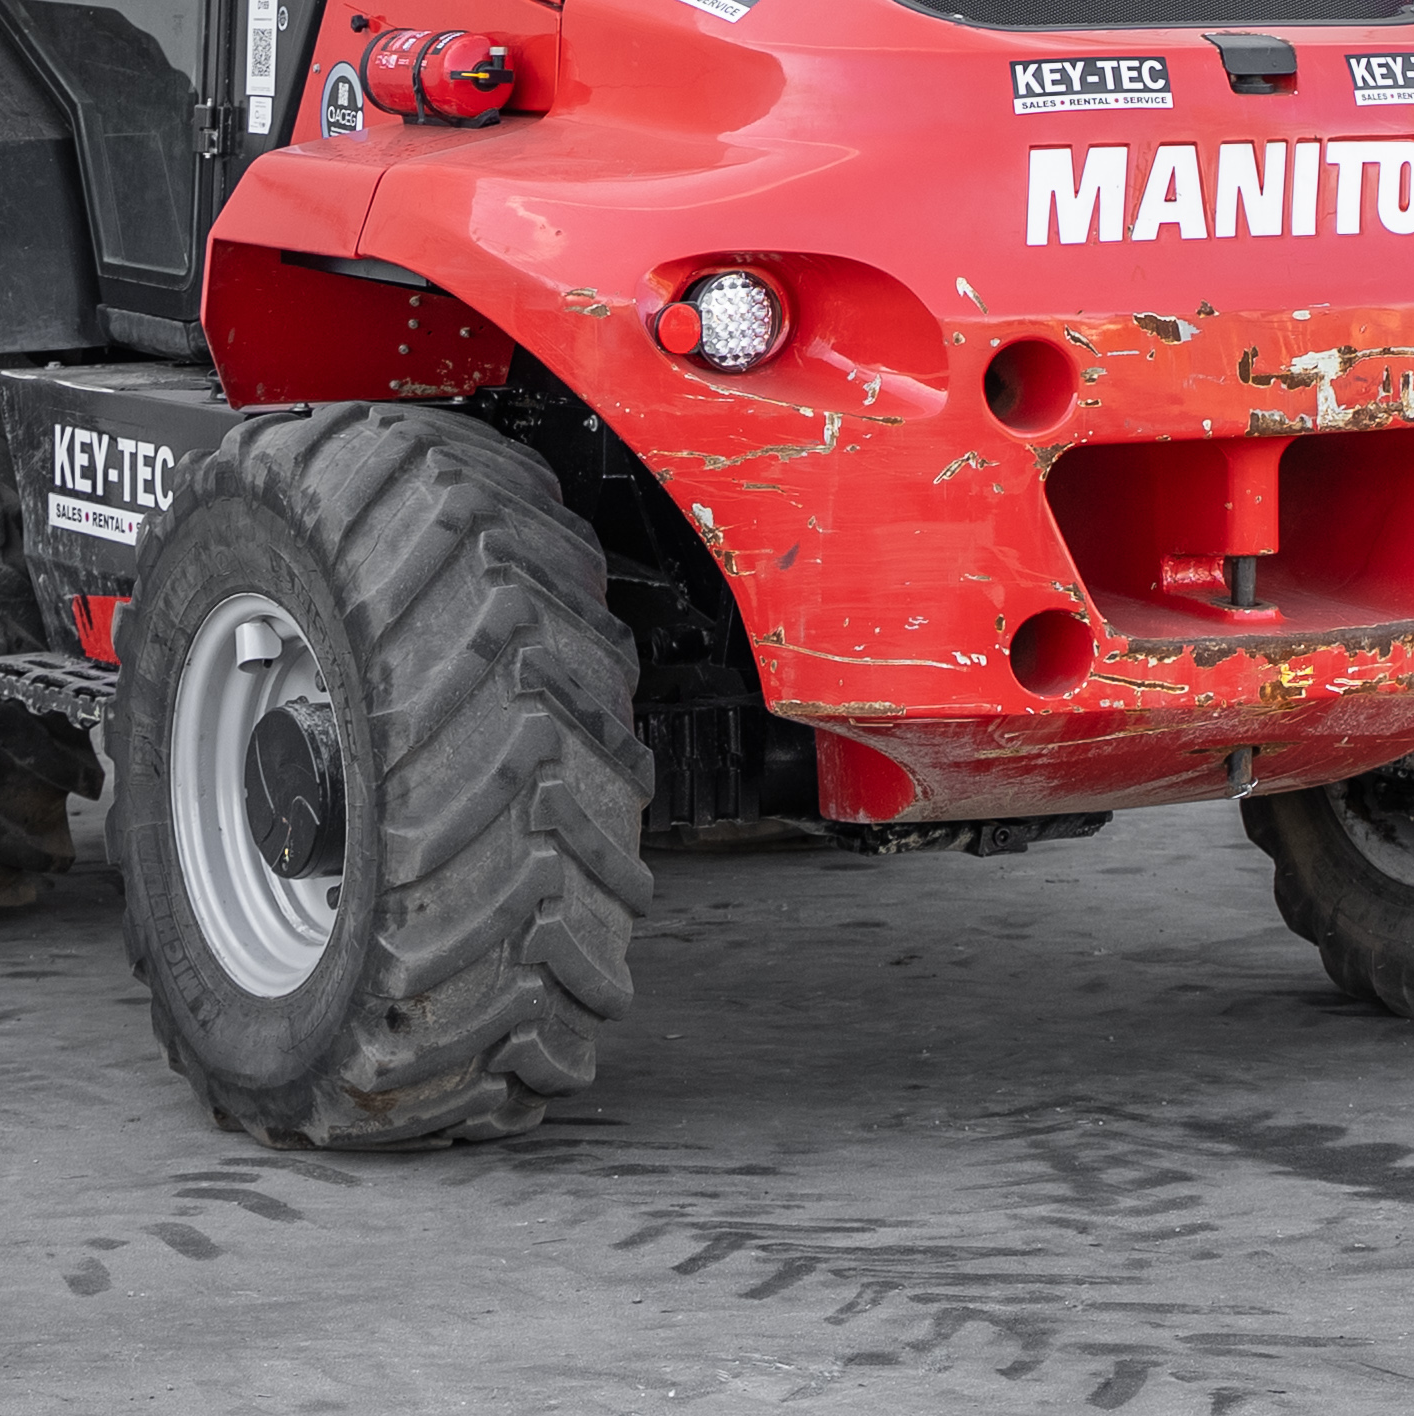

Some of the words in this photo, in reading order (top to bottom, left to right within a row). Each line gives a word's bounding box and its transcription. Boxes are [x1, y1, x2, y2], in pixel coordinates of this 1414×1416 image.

[1015, 60, 1166, 95] KEY-TEC
[1021, 99, 1057, 110] SALES
[1069, 97, 1111, 107] RENTAL
[1123, 96, 1168, 105] SERVICE
[1361, 93, 1388, 101] SALES
[54, 424, 175, 512] KEY-TEC
[55, 503, 82, 523] SALES
[92, 511, 126, 534] RENTAL
